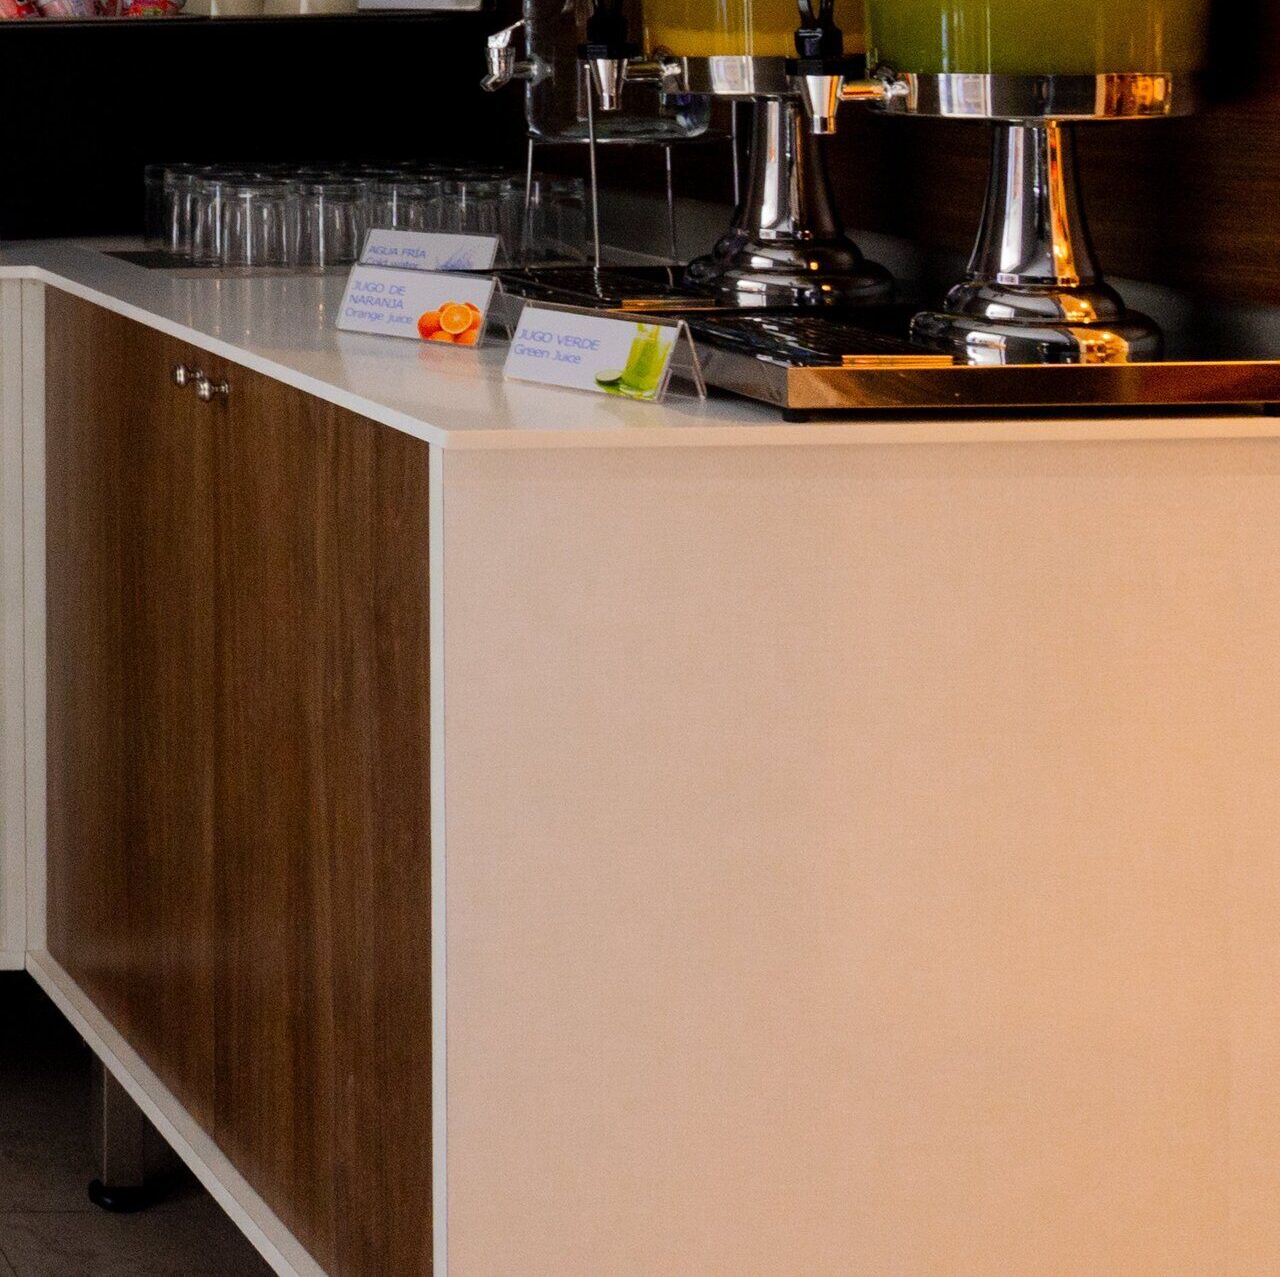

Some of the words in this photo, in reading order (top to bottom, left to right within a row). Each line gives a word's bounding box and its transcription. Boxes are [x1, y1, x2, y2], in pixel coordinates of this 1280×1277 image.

[368, 245, 398, 256] AGUA
[352, 280, 385, 293] JUGO
[389, 284, 406, 296] DE
[349, 294, 404, 309] NARANJA
[345, 307, 384, 321] Orange
[518, 328, 553, 343] JUGO
[557, 334, 601, 351] VERDE
[514, 343, 550, 358] Green
